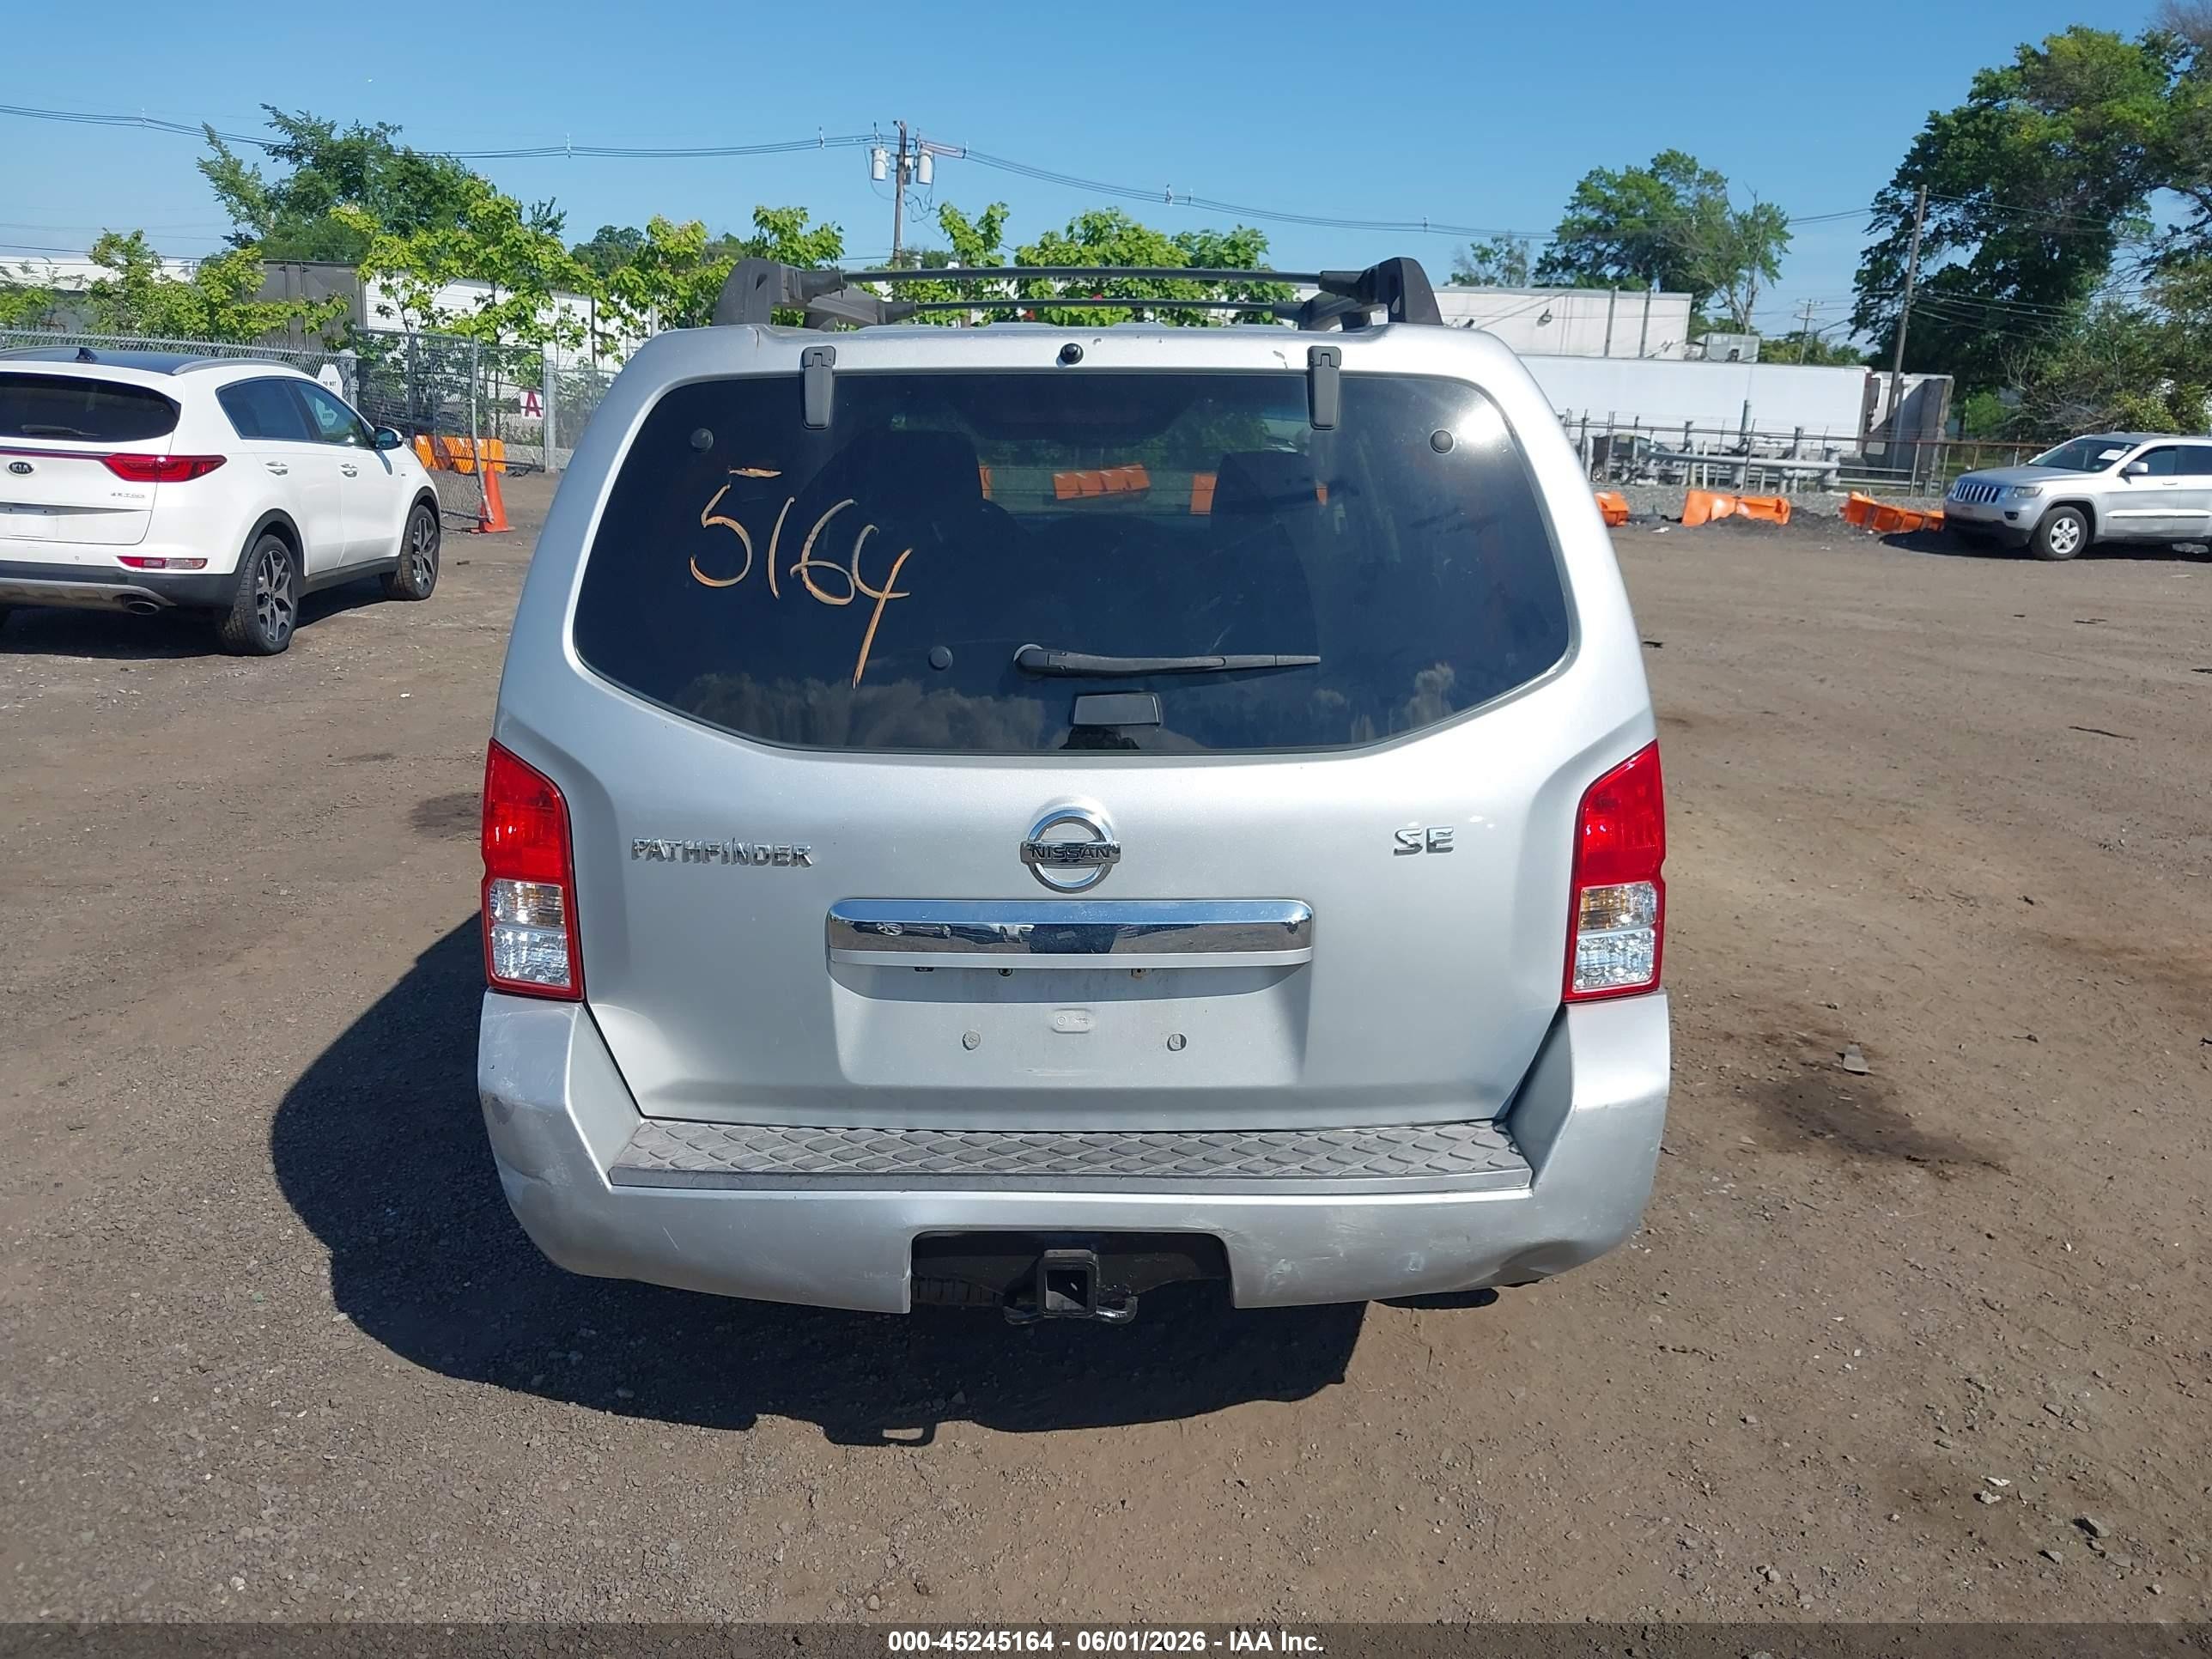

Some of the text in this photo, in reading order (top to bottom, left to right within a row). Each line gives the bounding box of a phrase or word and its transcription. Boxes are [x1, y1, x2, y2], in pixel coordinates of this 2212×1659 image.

[525, 391, 542, 417] A
[11, 464, 30, 472] KIA
[690, 467, 913, 690] 5164
[631, 837, 813, 867] PATHFINDER
[1031, 844, 1111, 860] NISSAN
[1393, 826, 1454, 855] SE
